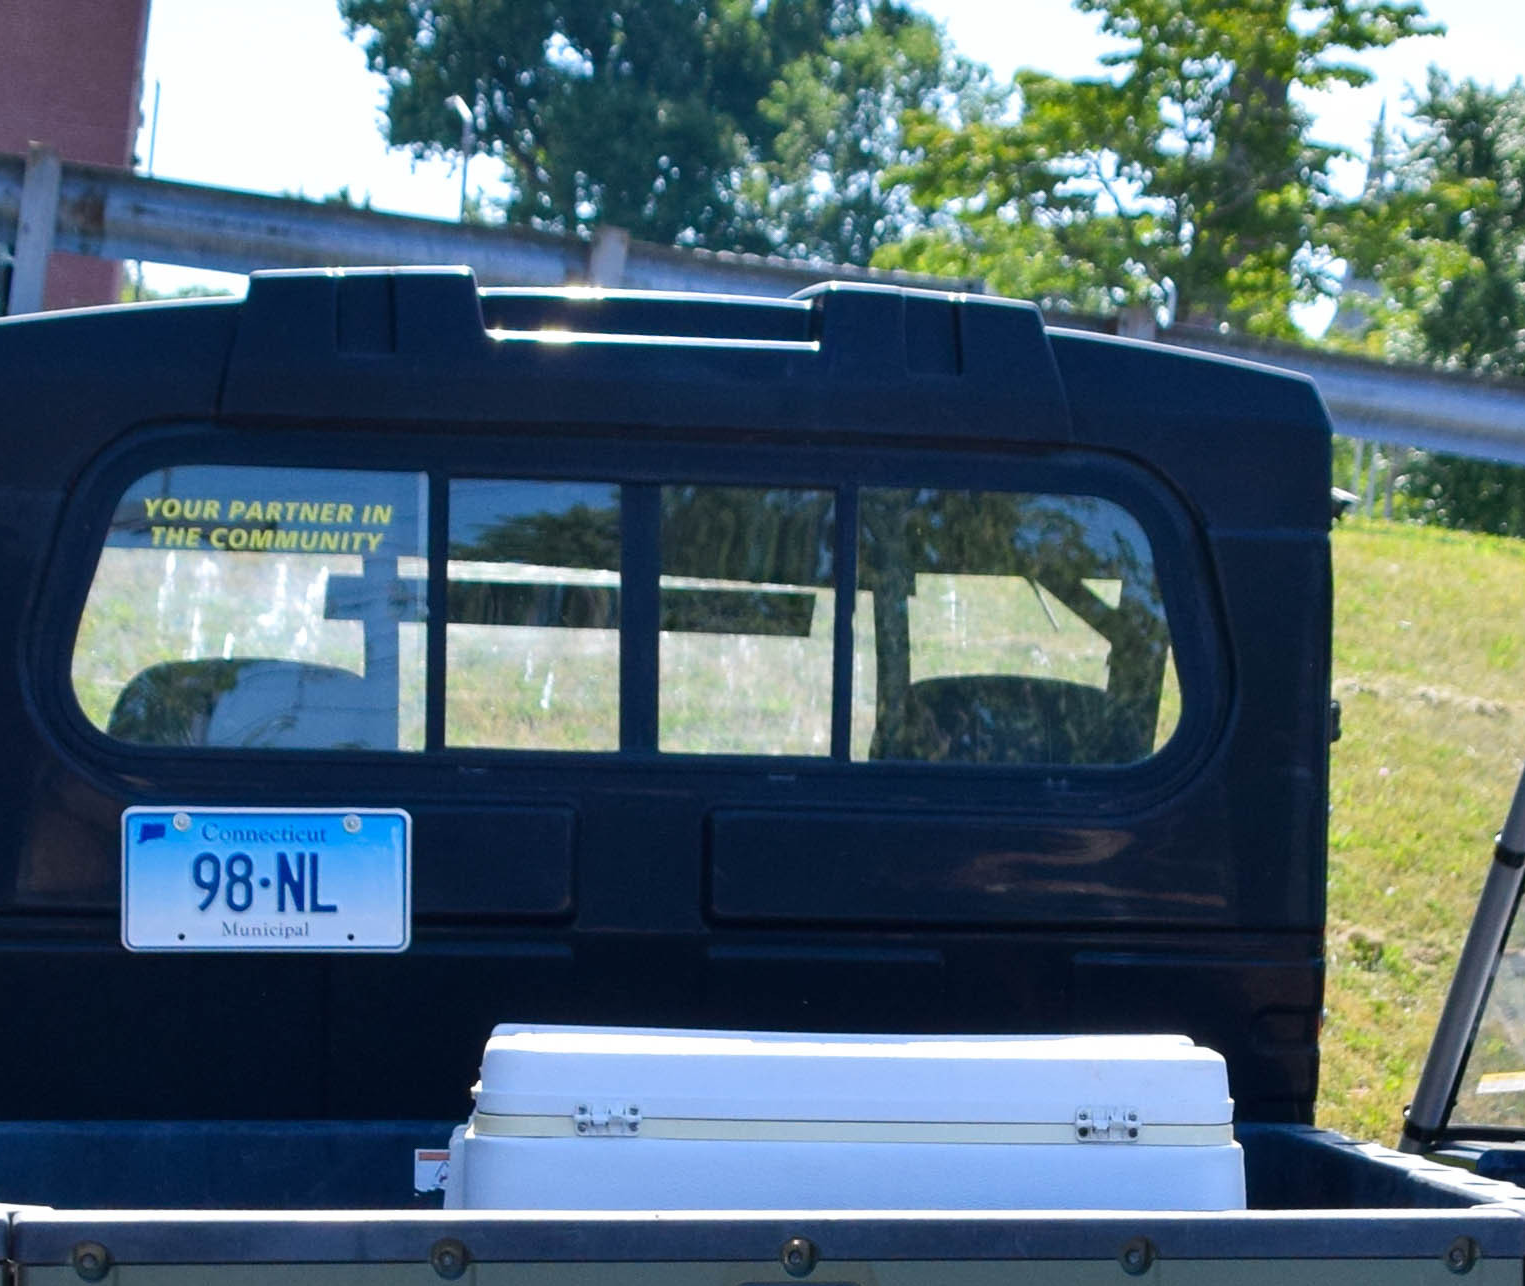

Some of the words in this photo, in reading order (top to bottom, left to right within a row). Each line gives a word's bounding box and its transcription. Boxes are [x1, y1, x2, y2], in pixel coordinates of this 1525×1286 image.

[144, 498, 221, 521] YOUR
[228, 500, 354, 523] PARTNER
[361, 504, 393, 525] IN
[151, 526, 203, 548] THE
[209, 527, 384, 553] COMMUNITY
[201, 822, 328, 843] Connecticut
[222, 921, 310, 939] Municipal
